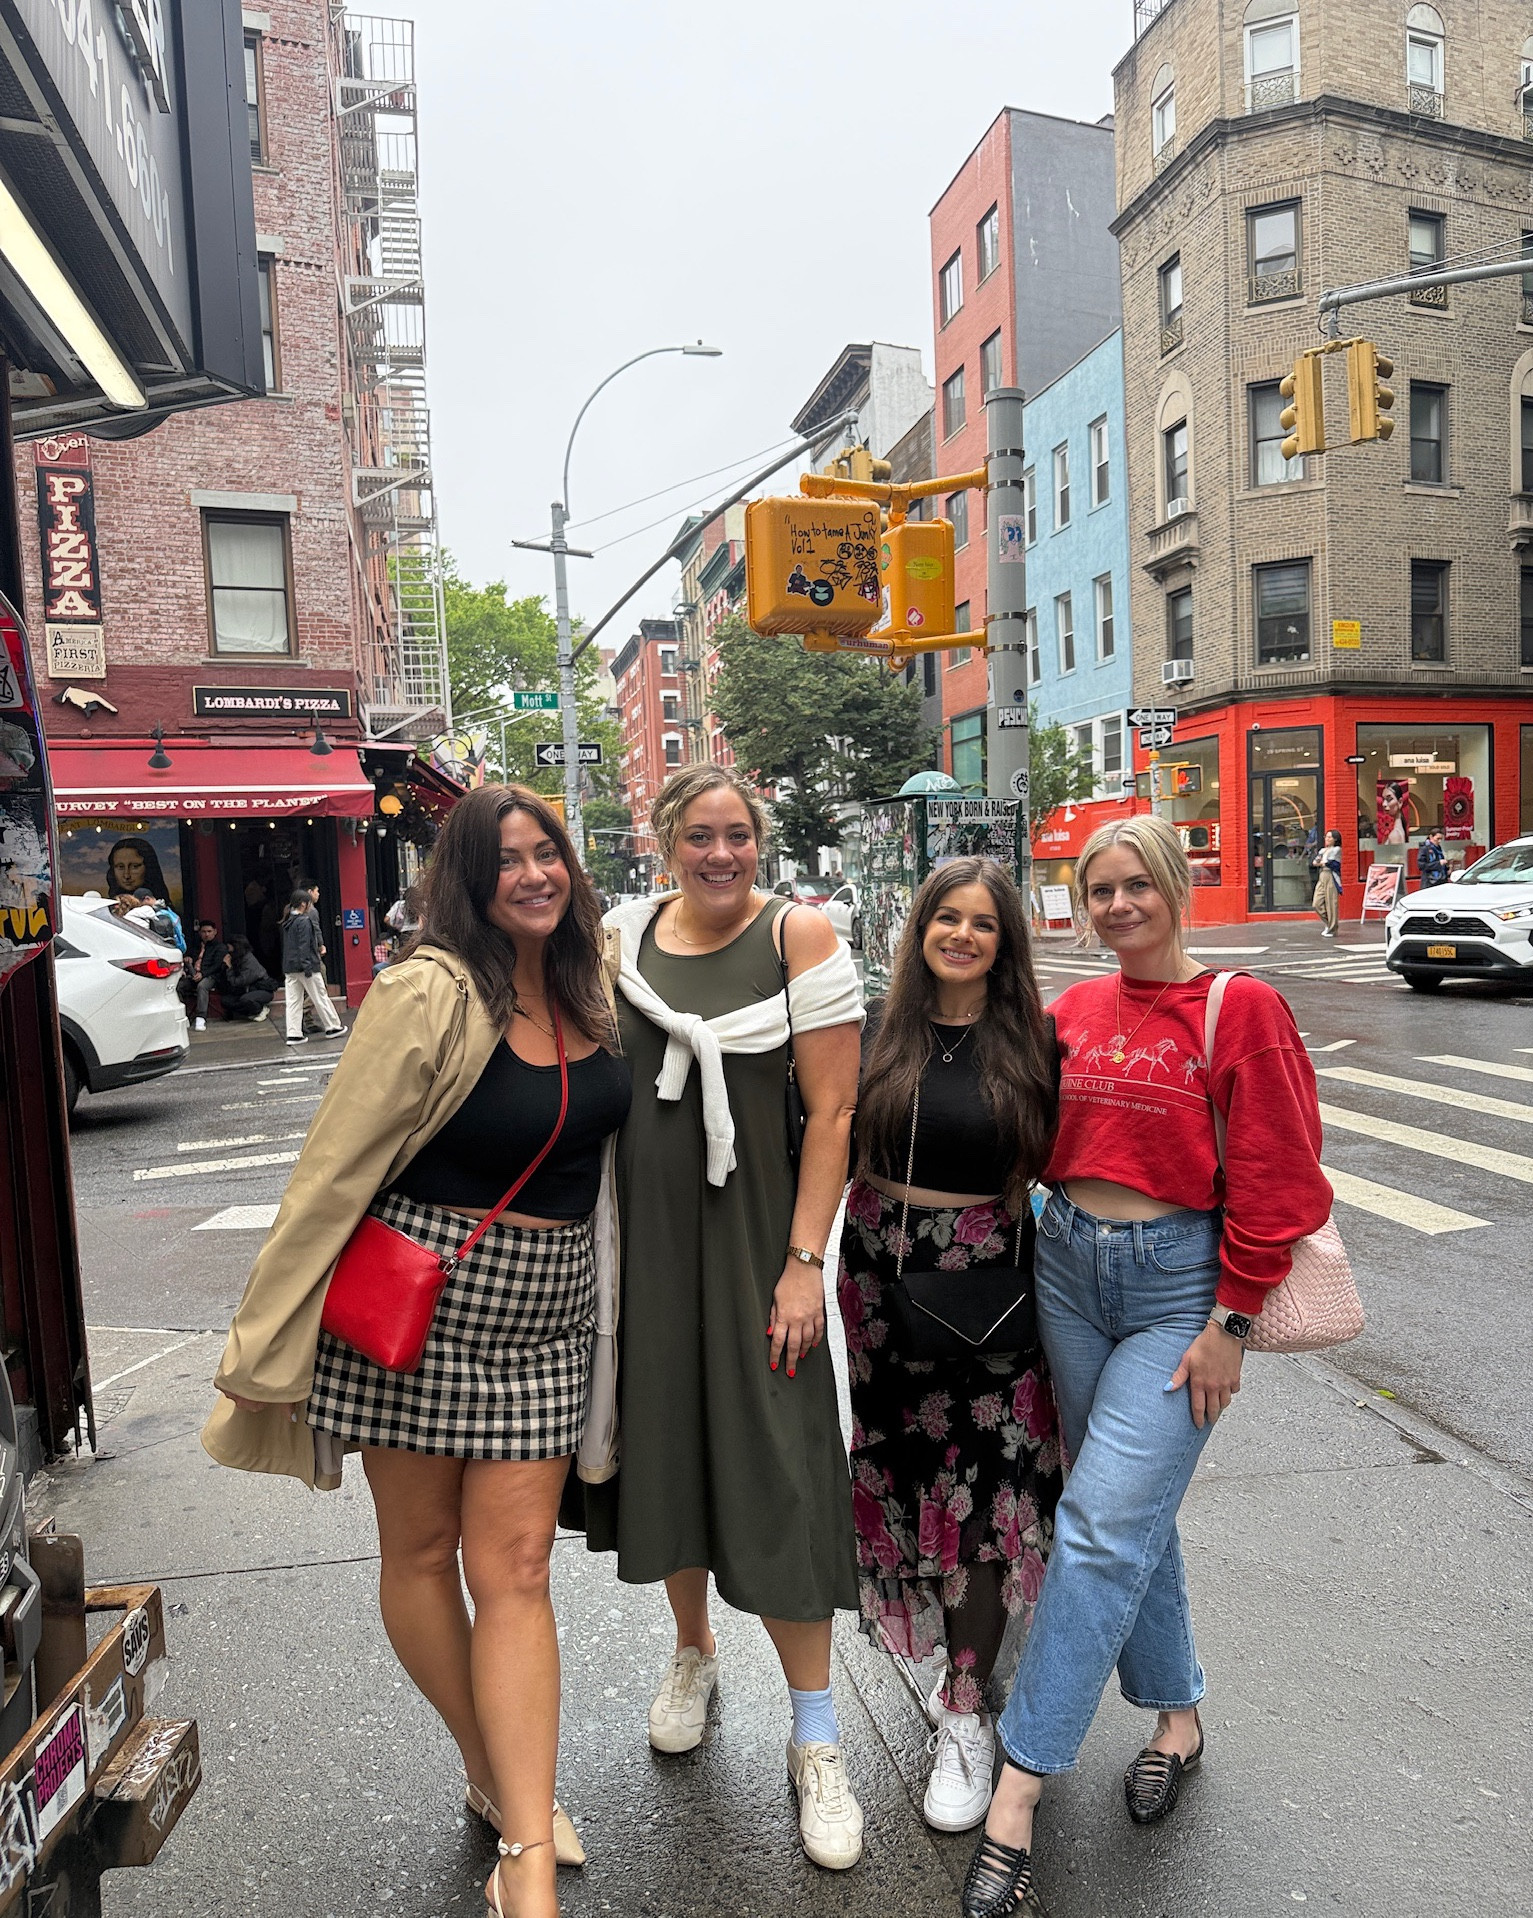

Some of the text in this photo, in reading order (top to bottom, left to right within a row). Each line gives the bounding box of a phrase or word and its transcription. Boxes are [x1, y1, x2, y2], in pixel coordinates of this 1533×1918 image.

[41, 436, 89, 461] Oven
[49, 475, 98, 616] PIZZA
[54, 648, 97, 660] FIRST
[54, 661, 100, 673] PIZZERIA
[204, 696, 340, 711] LOMBARDI'S PIZZA
[521, 694, 543, 708] Mott
[1135, 714, 1149, 722] ONE
[546, 750, 594, 760] ONE AY
[1416, 756, 1429, 764] luisa
[55, 801, 119, 812] URVEY
[183, 800, 206, 809] ON
[210, 800, 248, 809] THE
[928, 801, 943, 818] NEW
[945, 801, 963, 818] YORK
[964, 801, 982, 818] BORN
[984, 801, 990, 817] &
[1084, 1079, 1115, 1091] CLUB
[1088, 1096, 1130, 1108] VETERINARY
[1131, 1102, 1168, 1115] MEDICINE
[35, 1712, 80, 1786] CHROMA
[37, 1735, 84, 1811] PROJECTS
